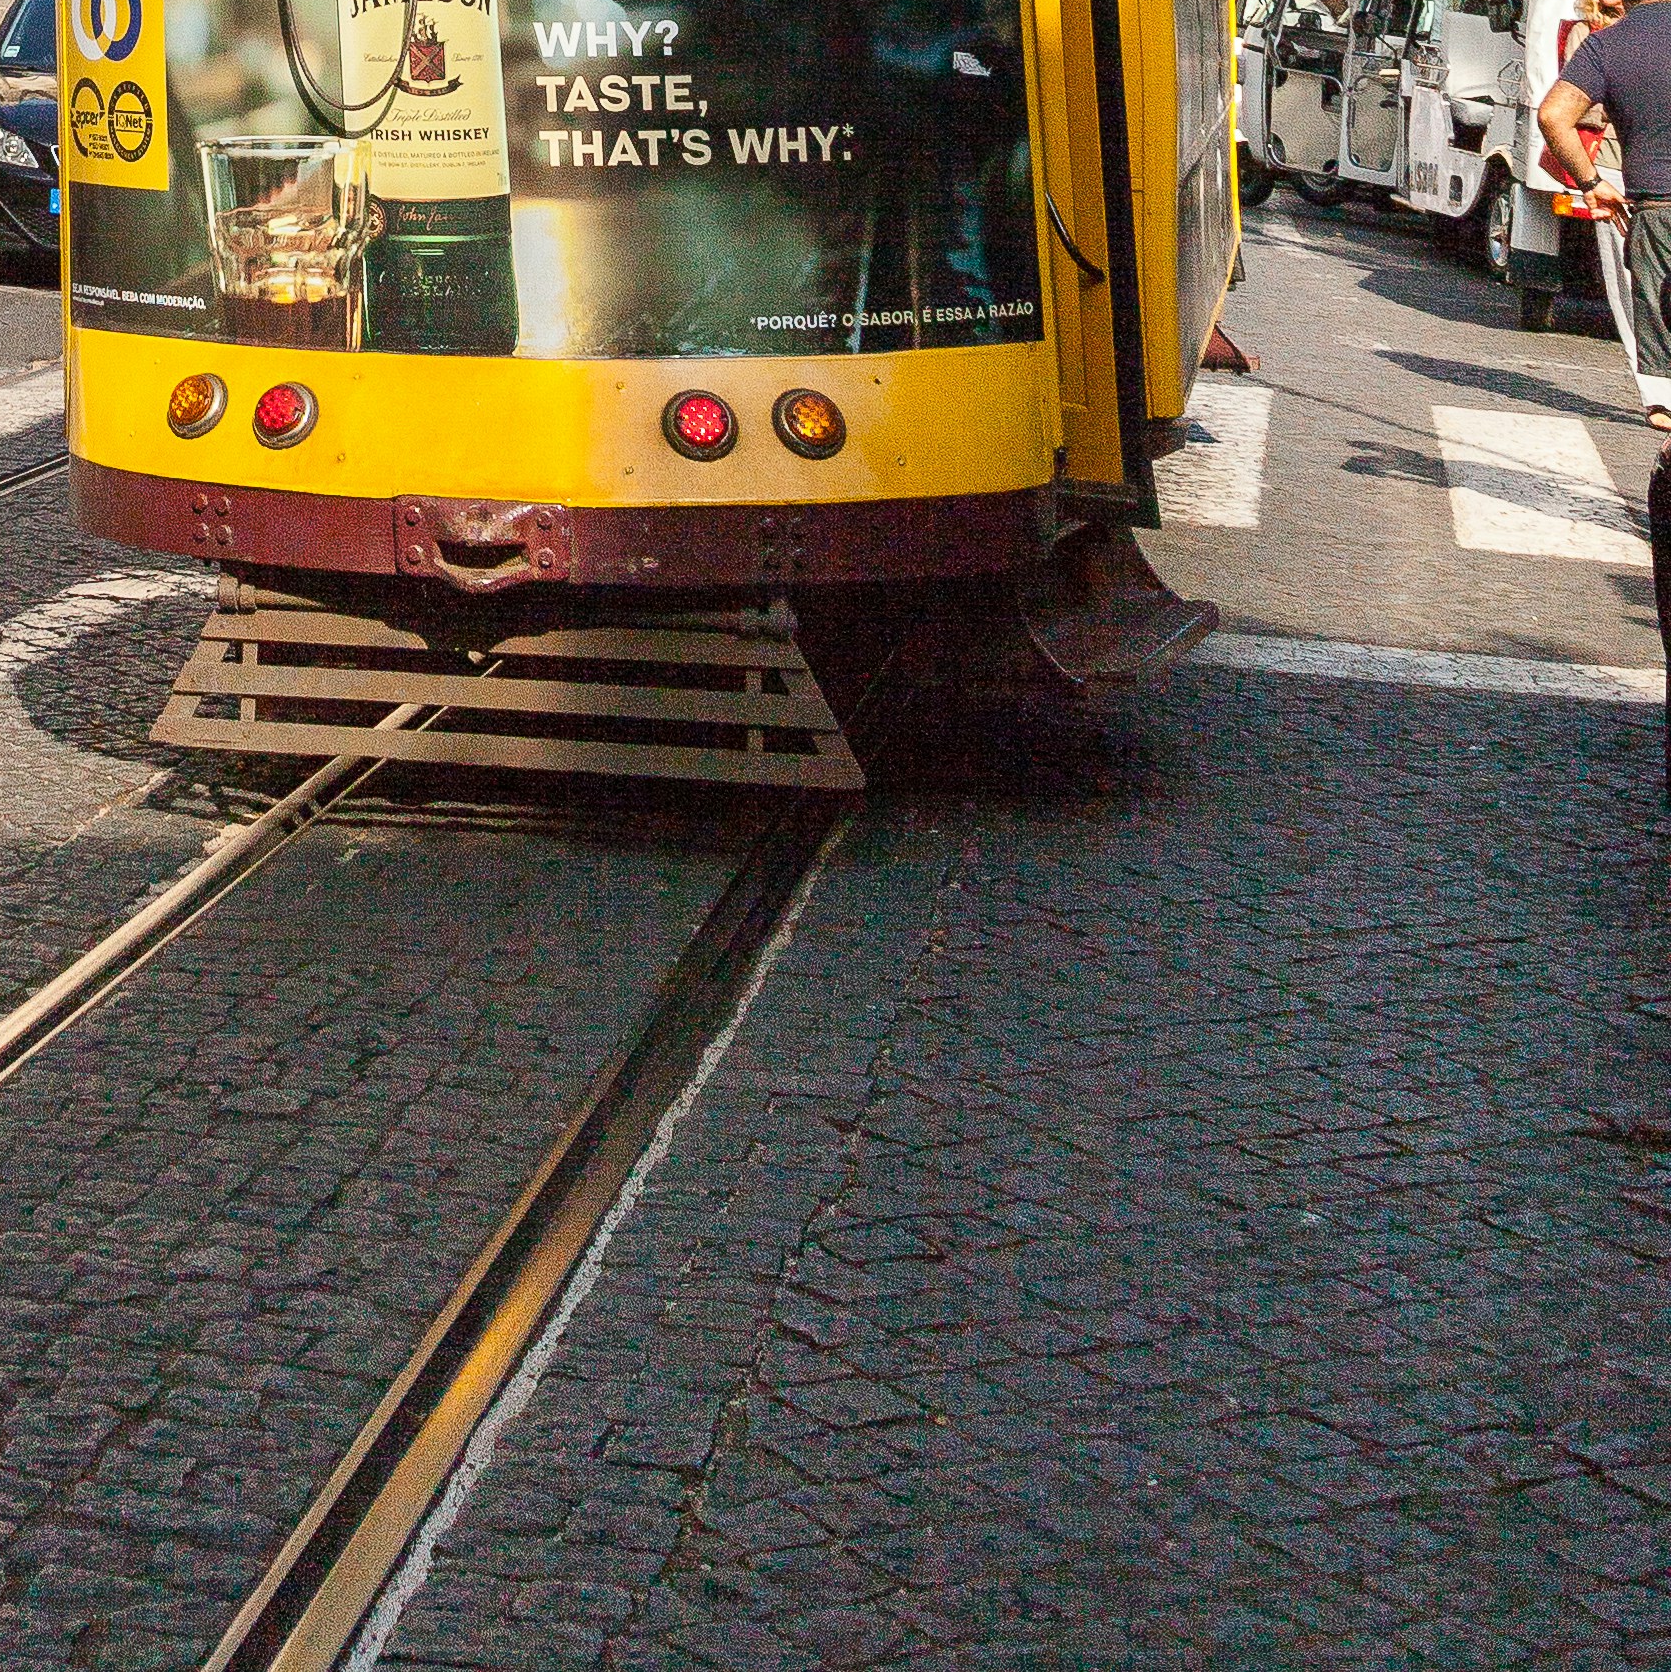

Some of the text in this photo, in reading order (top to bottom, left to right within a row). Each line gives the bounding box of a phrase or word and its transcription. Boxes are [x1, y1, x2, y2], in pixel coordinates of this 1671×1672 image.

[532, 20, 679, 57] WHY?
[535, 74, 708, 118] TASTE,
[386, 107, 472, 127] Triple Distilled
[370, 127, 490, 142] IRISH WHISKEY
[539, 128, 712, 167] THAT’S
[842, 313, 853, 327] O
[860, 311, 919, 327] SABOR,
[923, 306, 932, 323] É
[936, 308, 972, 322] ESSA
[976, 305, 986, 319] A
[989, 299, 1034, 318] RAZÃO
